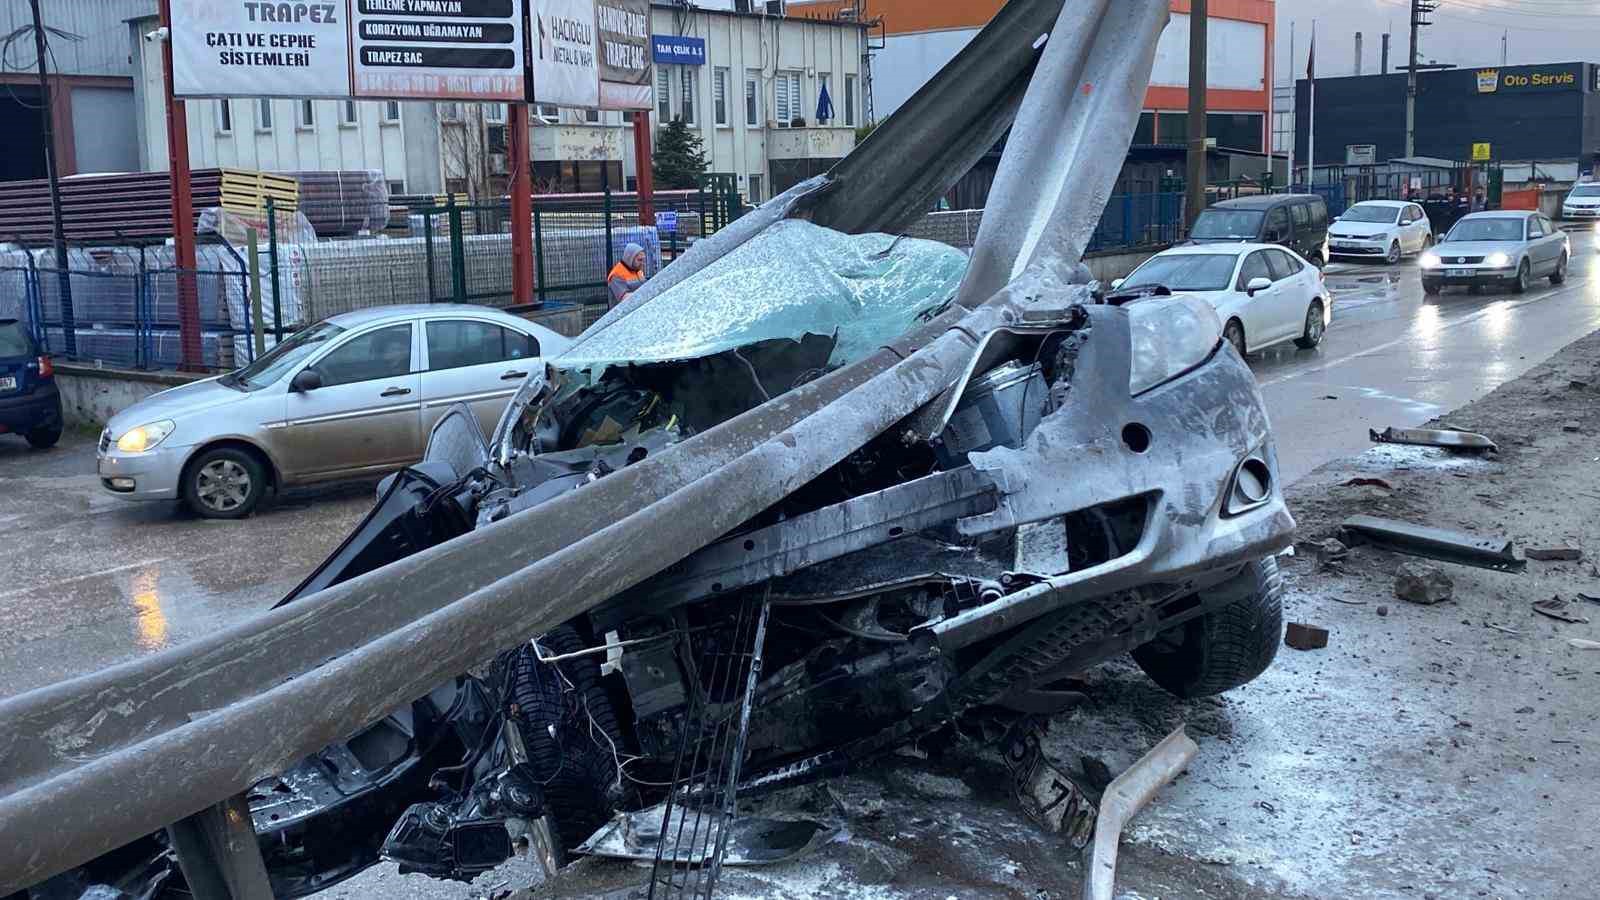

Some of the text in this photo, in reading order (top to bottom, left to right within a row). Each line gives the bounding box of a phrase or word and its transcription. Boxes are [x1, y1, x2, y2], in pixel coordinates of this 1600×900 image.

[244, 2, 337, 24] TRAPEZ
[408, 0, 462, 13] YAPMAYAN
[365, 23, 482, 38] KOROZYONA UĞRAMAYAN
[206, 32, 317, 49] ÇATI VE CEPHE
[656, 43, 672, 54] TAM
[219, 49, 310, 67] SİSTEMLERİ
[367, 51, 423, 64] TRAPEZ SAC
[1504, 75, 1528, 87] Oto
[1531, 72, 1575, 86] Servis
